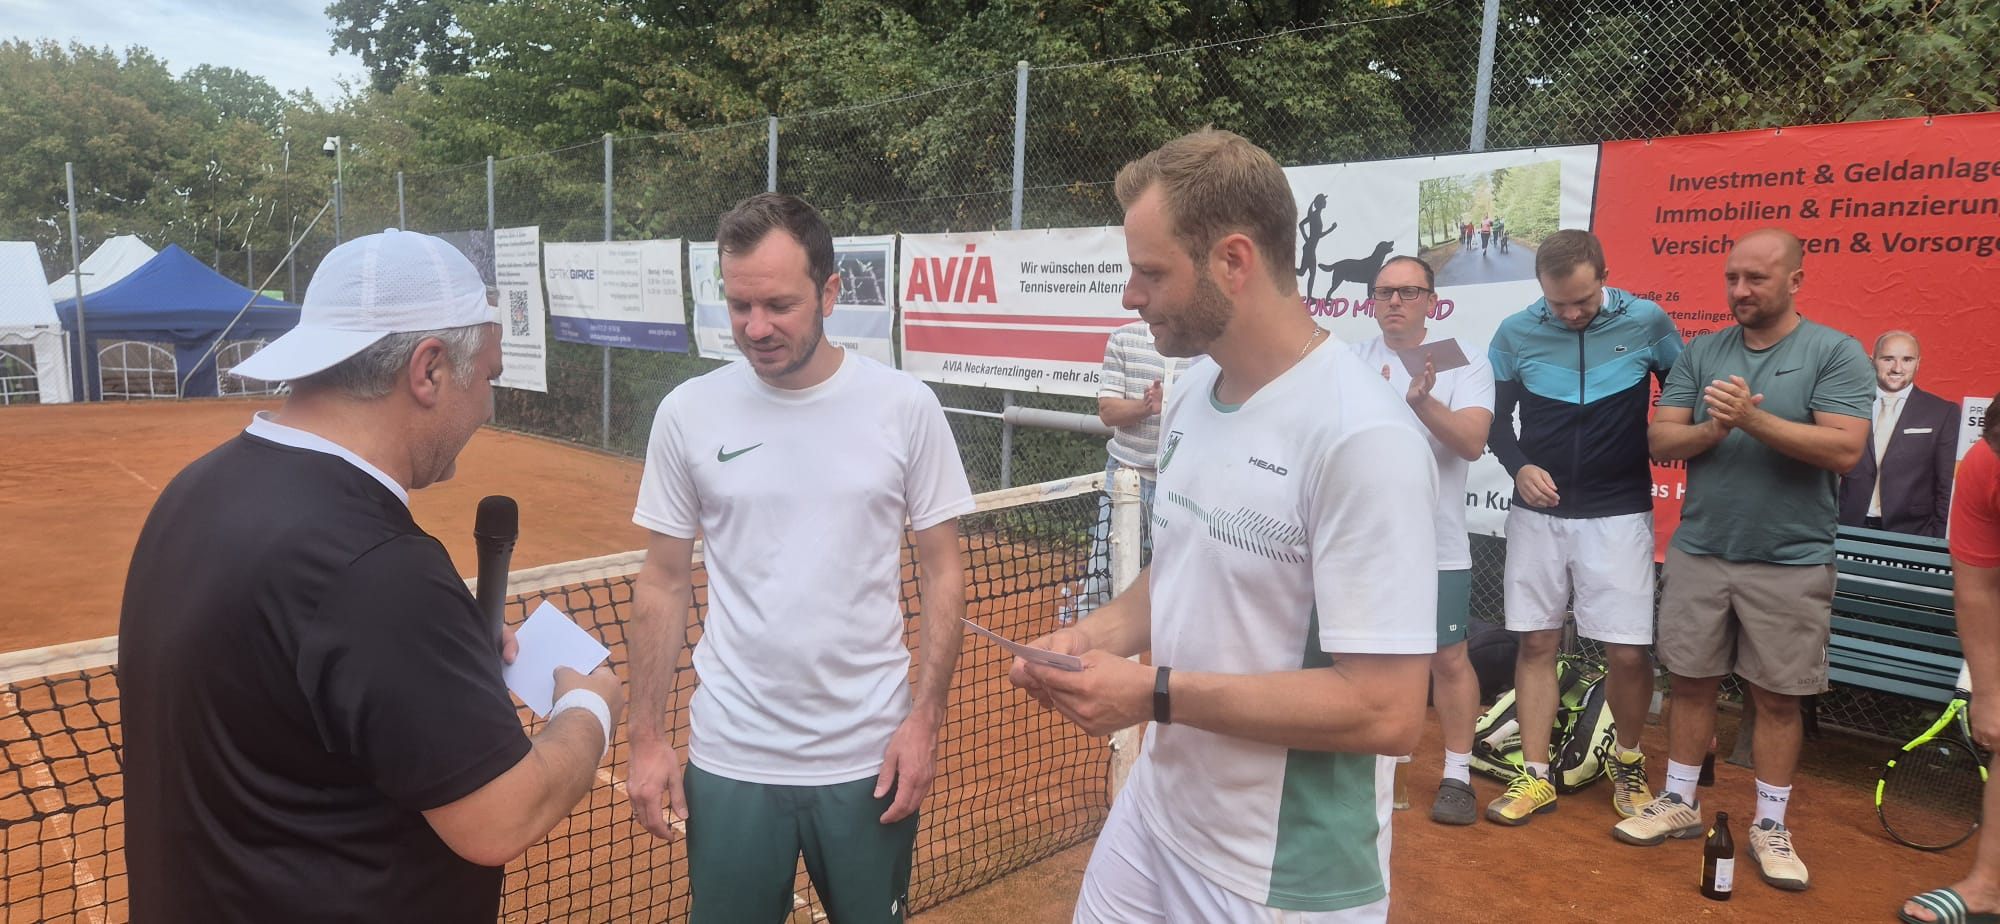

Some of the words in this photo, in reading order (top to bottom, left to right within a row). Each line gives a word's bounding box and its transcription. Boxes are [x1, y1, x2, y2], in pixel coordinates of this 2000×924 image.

[1669, 167, 1805, 192] Investment
[1813, 164, 1835, 185] &
[1655, 200, 1791, 224] Immobilien
[1800, 198, 1820, 219] &
[1829, 194, 2000, 220] Finanzierun
[1850, 232, 1872, 254] &
[570, 269, 595, 280] GIRKE
[906, 244, 997, 304] AVIA
[1020, 261, 1038, 274] Wir
[1041, 260, 1094, 274] wünschen
[1098, 261, 1123, 274] dem
[1020, 280, 1086, 294] Tennisverein
[1089, 280, 1127, 294] Altenri
[1632, 290, 1662, 302] traße
[1665, 291, 1680, 302] 26
[1667, 309, 1734, 323] rtenzlingen
[942, 360, 962, 374] AVIA
[964, 361, 1043, 380] Neckartenzlingen
[1053, 370, 1081, 383] mehr
[1968, 416, 1986, 428] SE
[1248, 456, 1288, 476] HEAD
